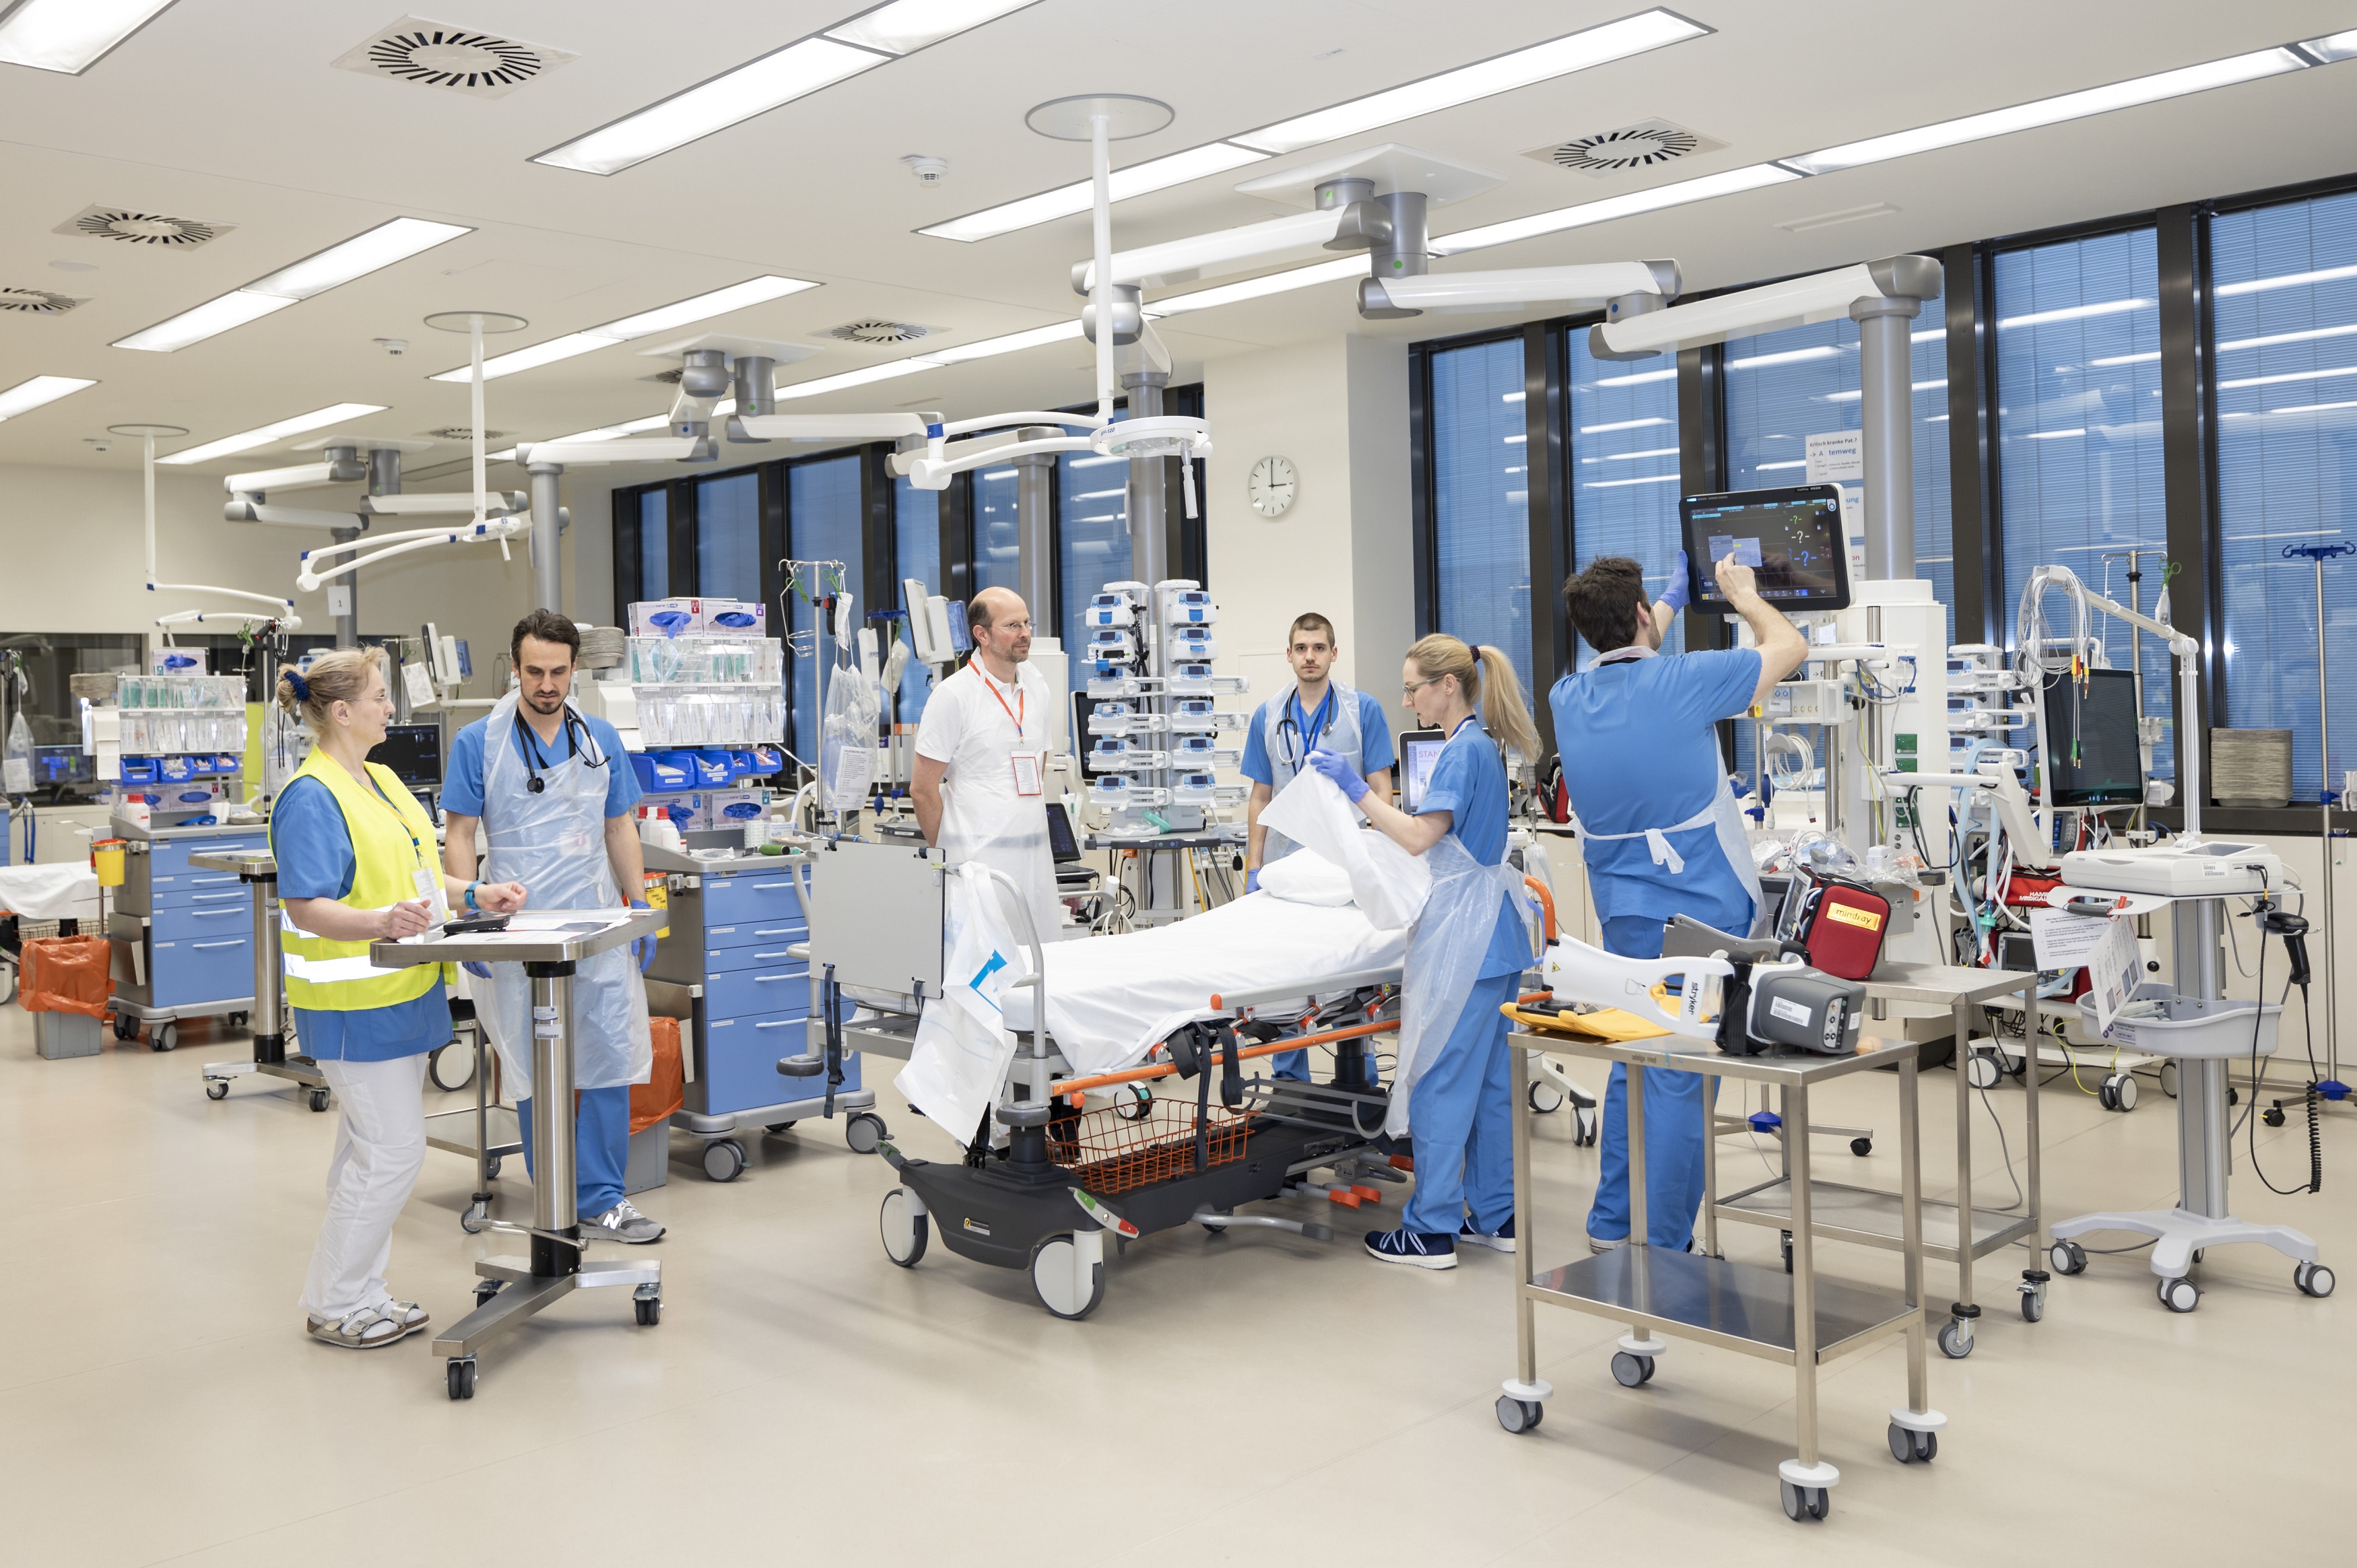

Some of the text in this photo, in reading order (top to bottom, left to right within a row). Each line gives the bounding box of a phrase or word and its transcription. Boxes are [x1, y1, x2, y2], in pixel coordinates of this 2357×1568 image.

[1829, 448, 1856, 456] temweg
[1836, 909, 1872, 924] mindray
[1688, 981, 1699, 1015] stryker
